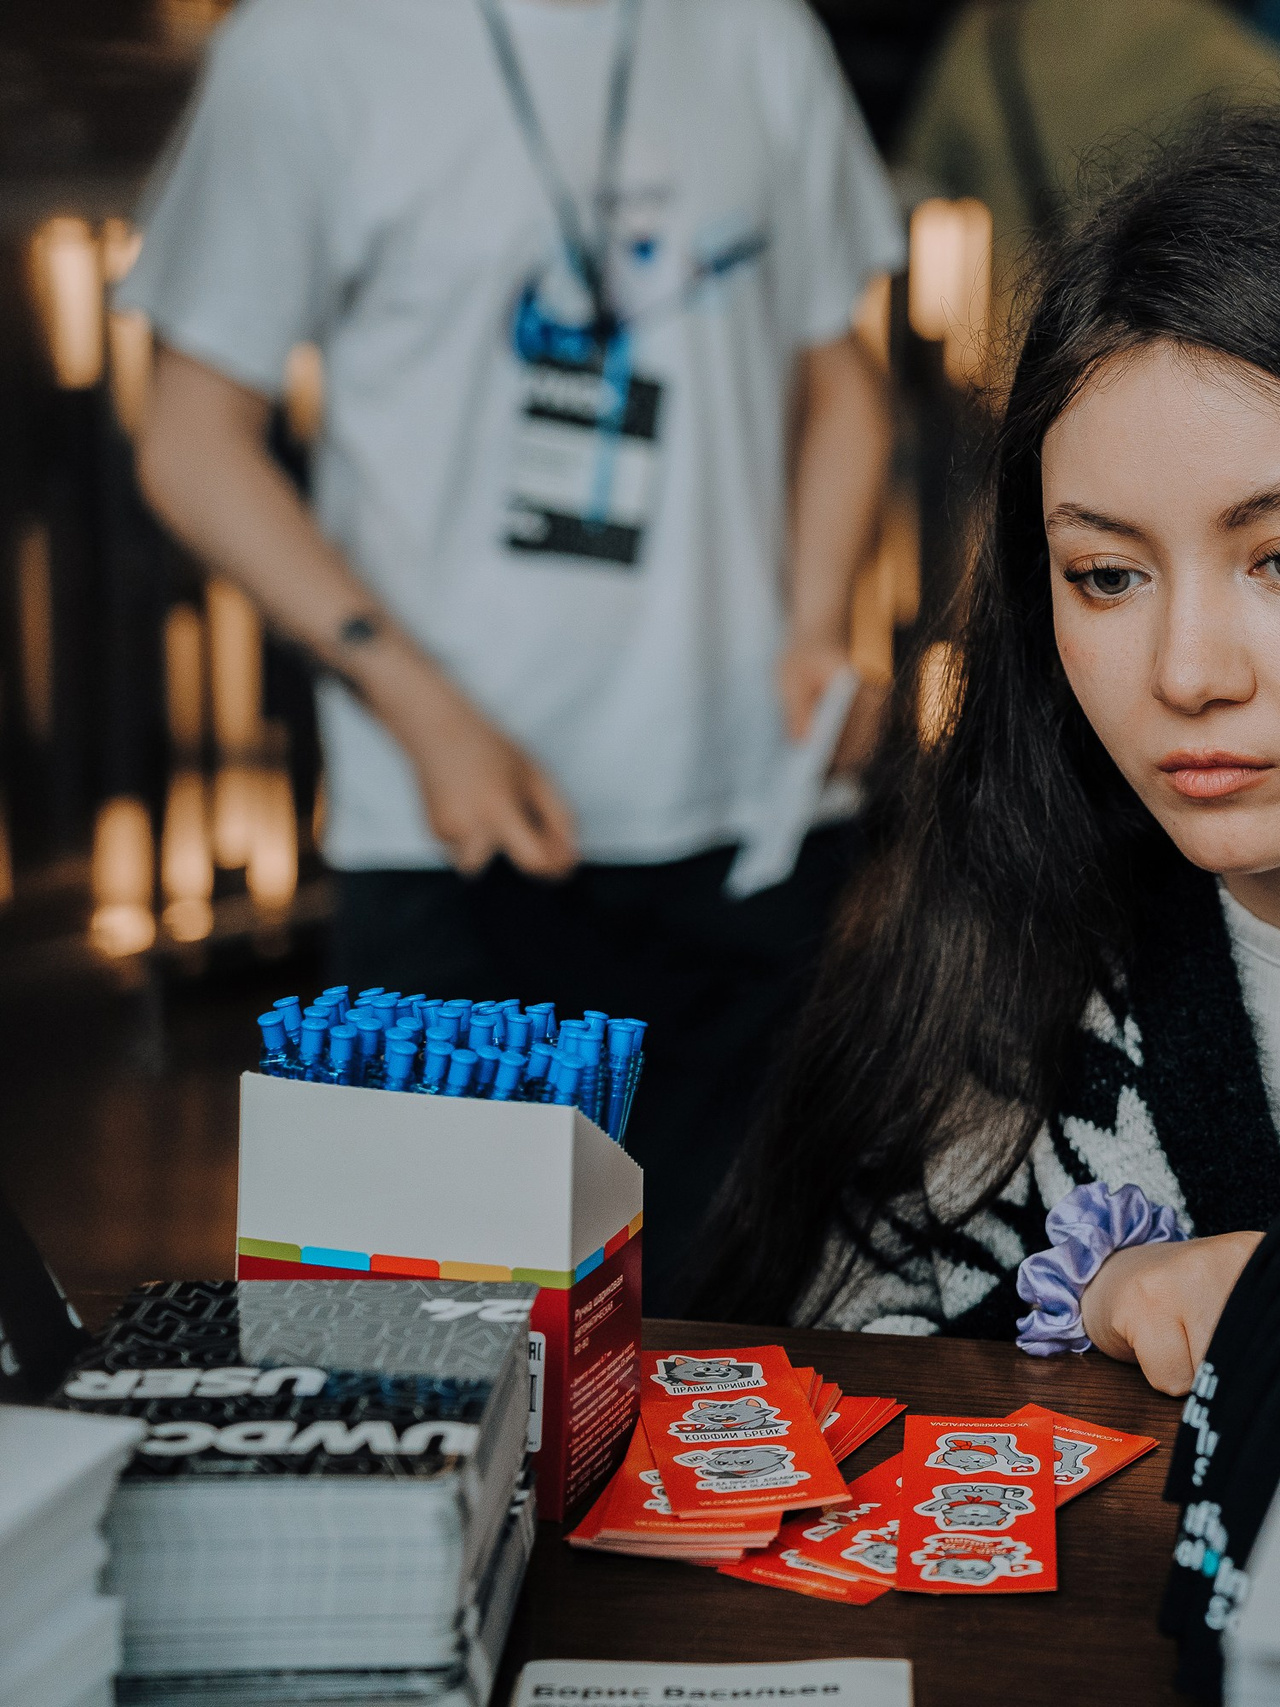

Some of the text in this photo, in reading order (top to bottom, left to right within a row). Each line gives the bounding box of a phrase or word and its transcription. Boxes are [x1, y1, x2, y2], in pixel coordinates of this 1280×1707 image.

[65, 1366, 329, 1399] USER
[672, 1379, 761, 1394] ПРАВКИ ПРИШЛИ
[139, 1420, 480, 1456] UWDC
[687, 1455, 704, 1464] NO
[532, 1682, 840, 1701] Борис Васильев
